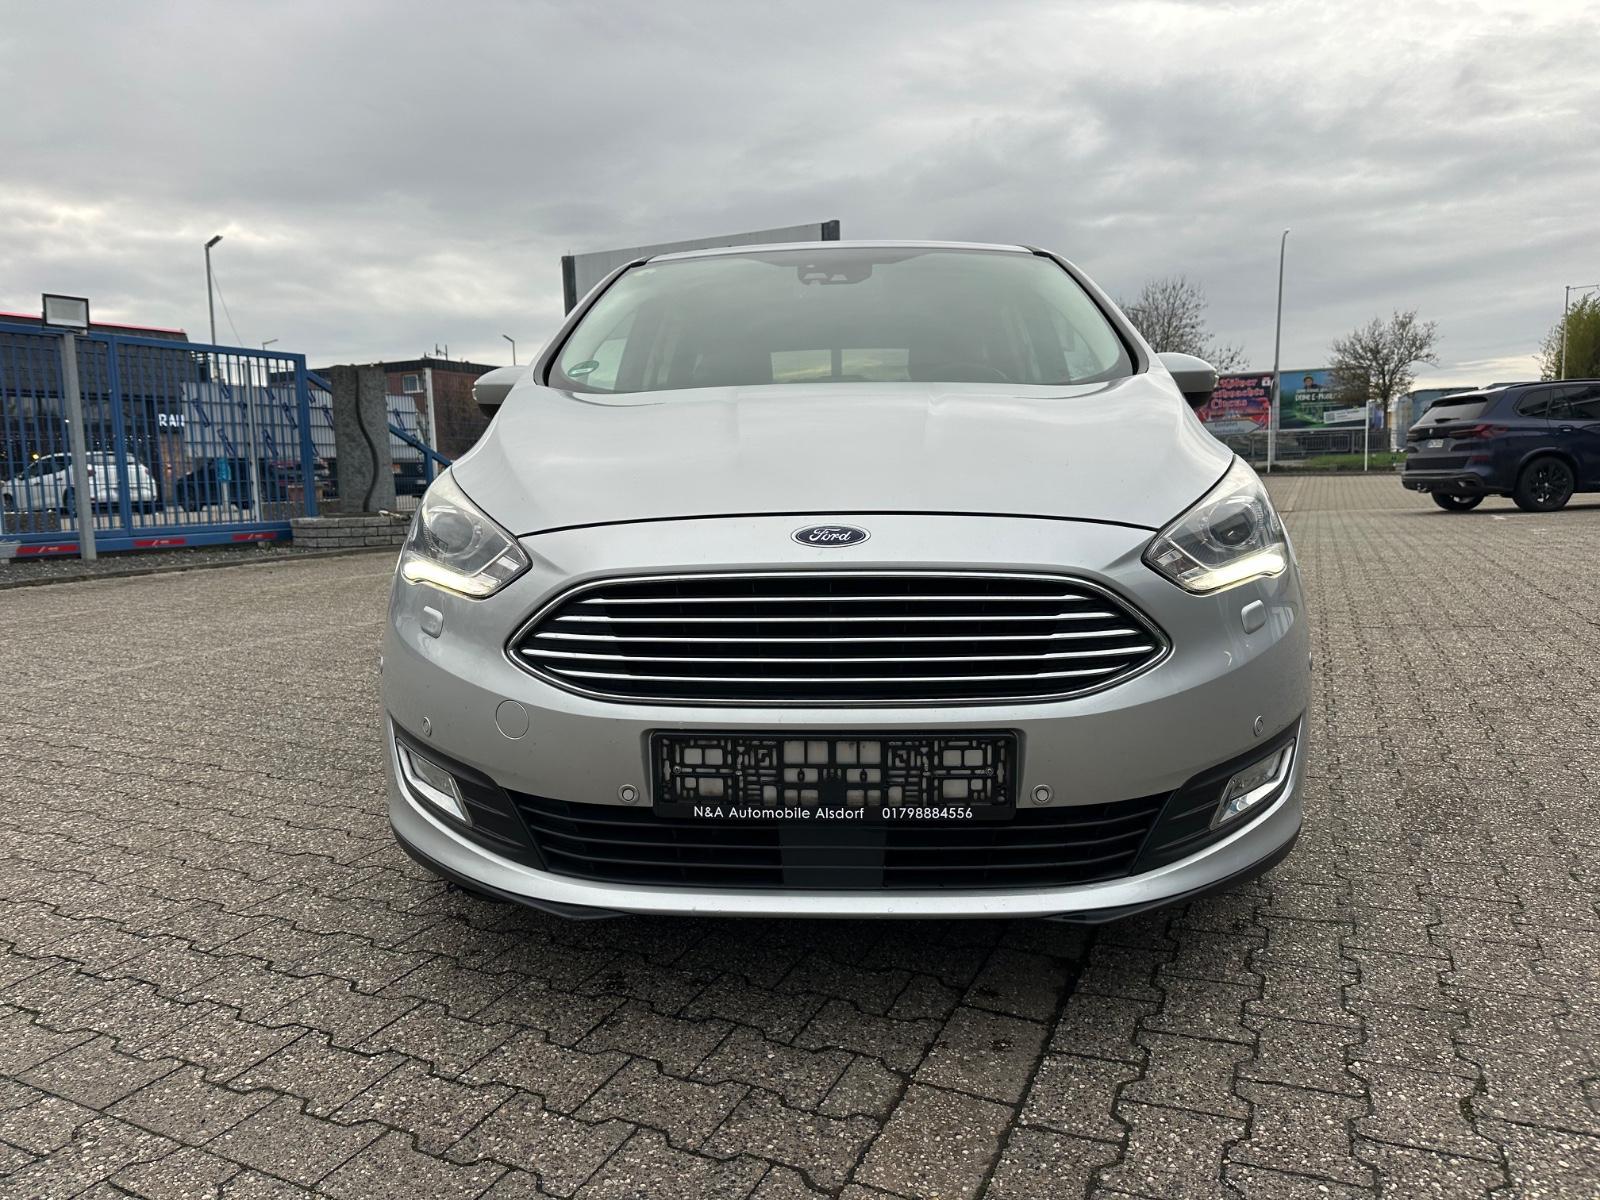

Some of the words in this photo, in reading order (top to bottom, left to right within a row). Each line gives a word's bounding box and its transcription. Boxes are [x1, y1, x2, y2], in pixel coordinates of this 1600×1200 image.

[809, 528, 852, 541] Ford
[693, 806, 724, 818] N&A
[728, 807, 811, 819] Automobile
[815, 807, 865, 819] Alsdorf
[882, 807, 973, 819] 01798884556
